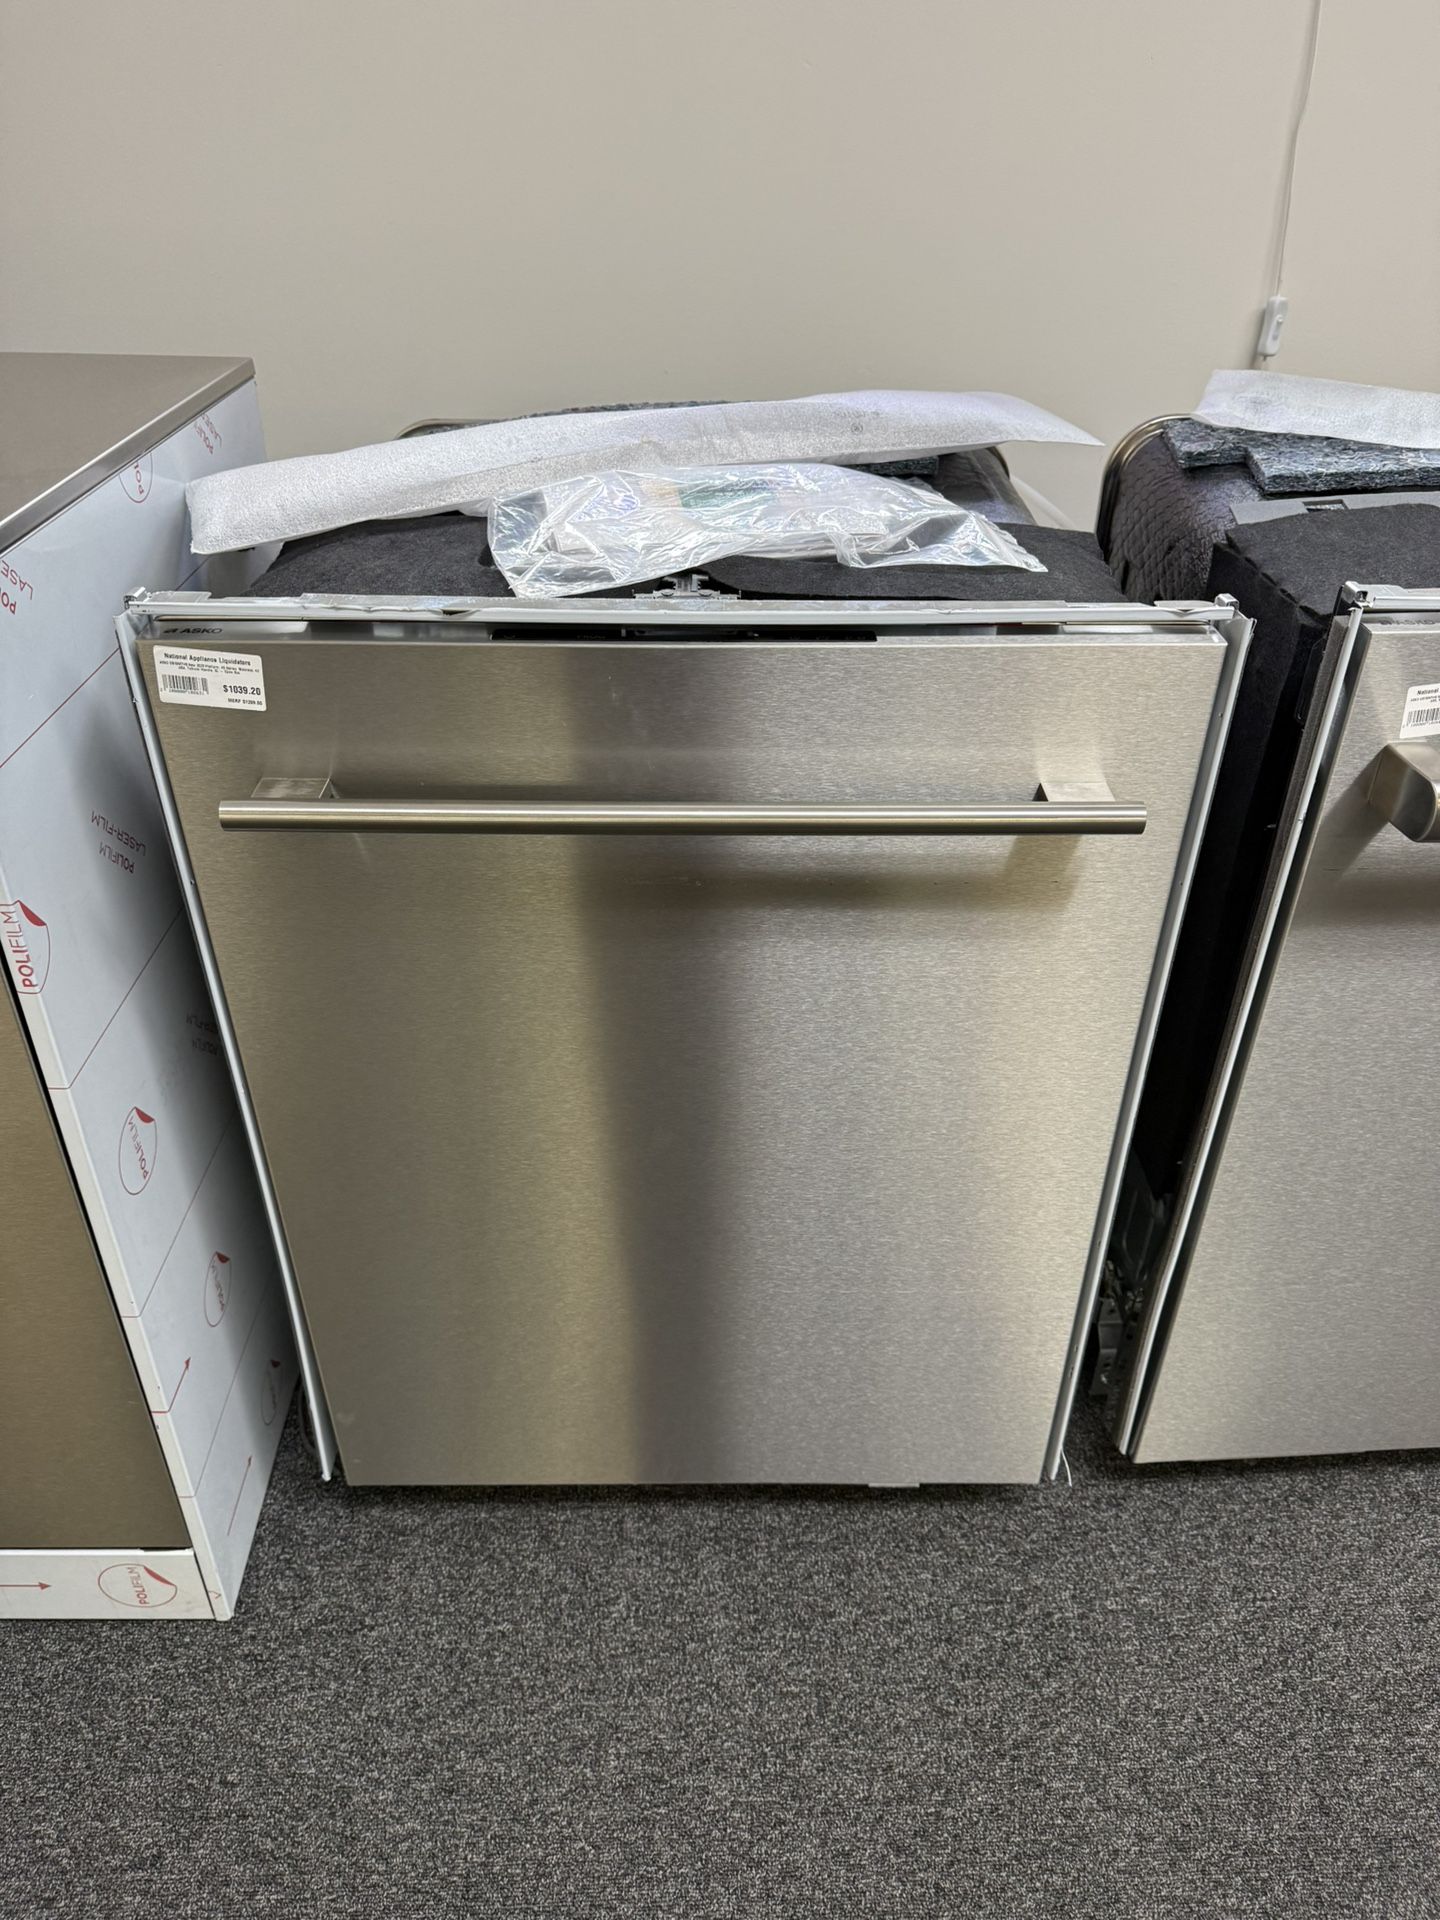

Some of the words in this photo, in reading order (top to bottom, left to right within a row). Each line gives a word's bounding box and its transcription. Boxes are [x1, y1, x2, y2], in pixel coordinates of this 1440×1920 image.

[164, 652, 188, 660] National
[189, 654, 217, 663] Appliance
[218, 657, 251, 666] Liquidators
[222, 684, 261, 696] $1039.20
[91, 810, 147, 857] LASER-FILM
[99, 842, 135, 874] POLIFILM
[0, 910, 38, 988] POLIFILM
[128, 1115, 149, 1180] POLIFILM
[127, 1566, 150, 1605] POLIFILM
